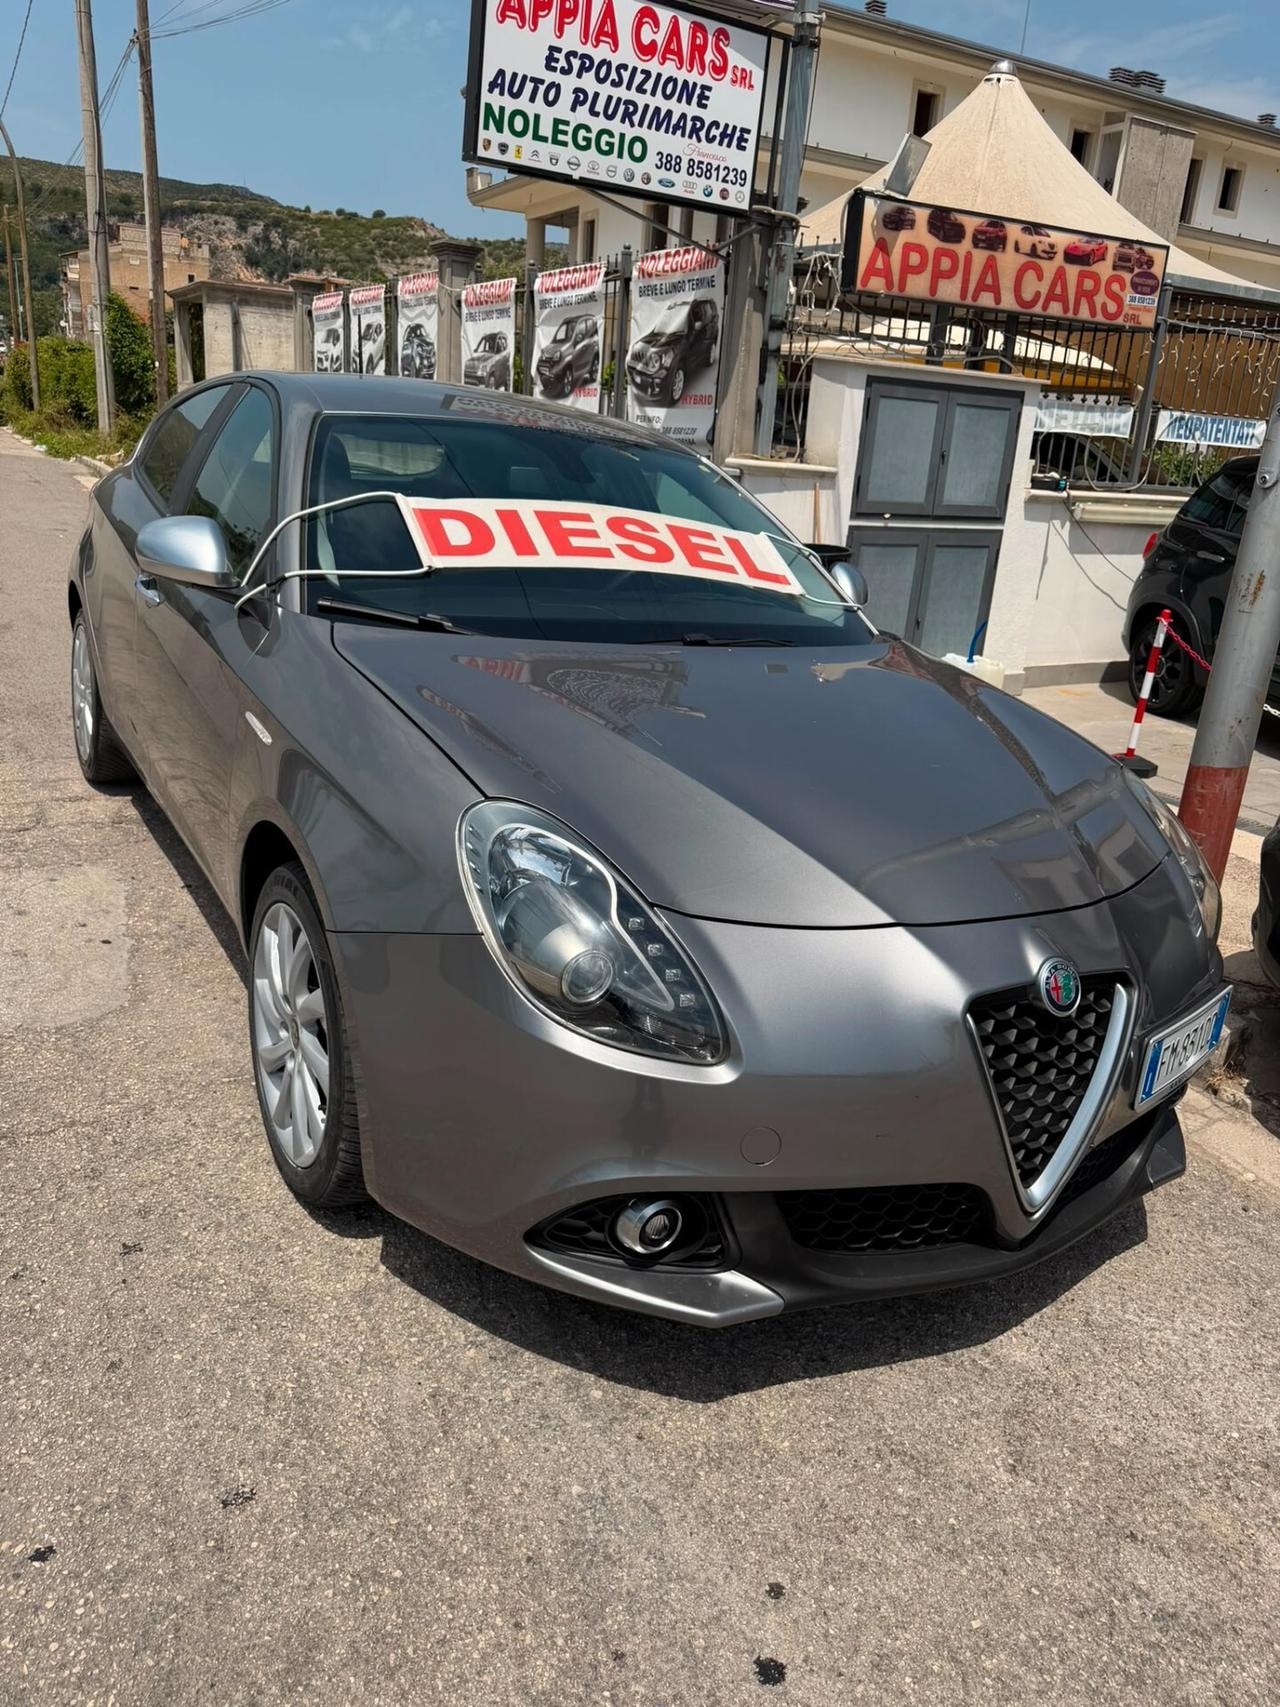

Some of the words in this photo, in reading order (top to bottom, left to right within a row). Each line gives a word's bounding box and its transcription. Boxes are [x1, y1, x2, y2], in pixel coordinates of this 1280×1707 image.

[496, 0, 619, 53] APPIA
[631, 6, 730, 81] CARS
[730, 65, 754, 91] SRL
[544, 45, 713, 109] ESPOSIZIONE
[483, 102, 648, 163] NOLEGGIO
[487, 68, 561, 107] AUTO
[569, 86, 752, 151] PLURIMARCHE
[655, 151, 682, 173] 388
[686, 158, 747, 187] 8581239
[683, 143, 727, 162] Francesco
[638, 283, 658, 297] BREVE
[660, 283, 664, 295] E
[665, 279, 685, 295] LUNGO
[688, 275, 716, 292] TERMINE
[860, 237, 1002, 306] APPIA
[1013, 260, 1126, 322] CARS
[1122, 313, 1142, 325] SRL
[681, 394, 713, 405] HYBRID
[412, 508, 791, 586] DIESEL
